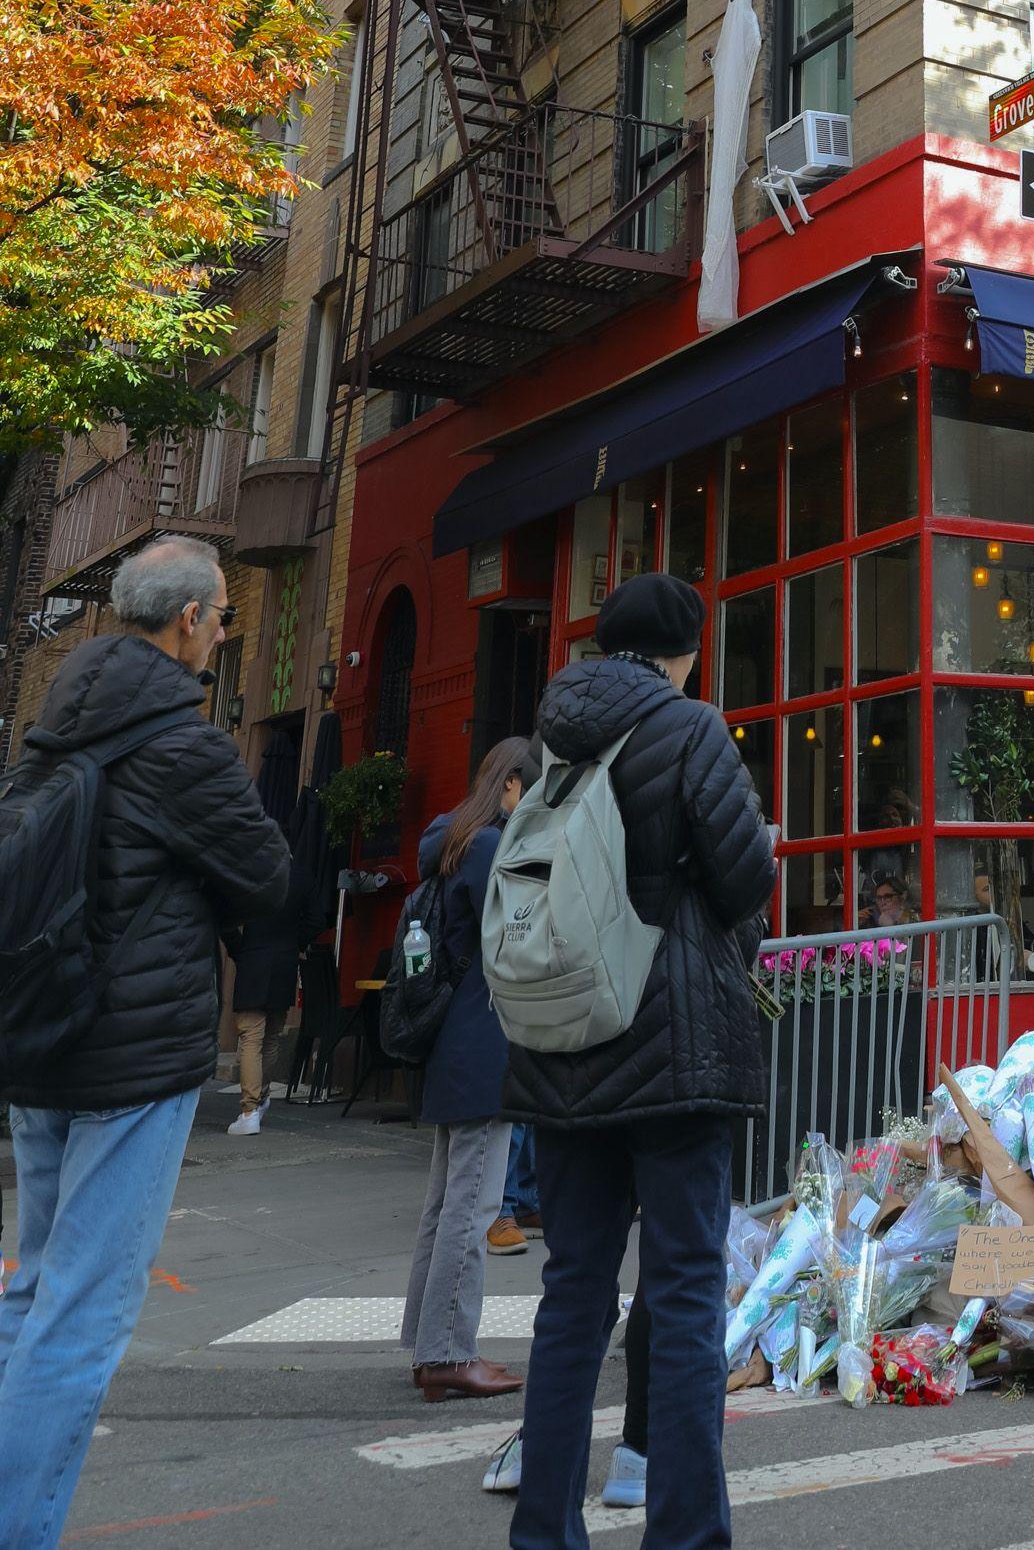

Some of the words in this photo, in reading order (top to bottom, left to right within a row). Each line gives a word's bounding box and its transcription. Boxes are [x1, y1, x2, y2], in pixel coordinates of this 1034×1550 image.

[993, 94, 1034, 134] Grove
[505, 922, 532, 931] SIERRA
[508, 932, 525, 941] CLUB
[960, 1249, 1002, 1258] where
[962, 1262, 986, 1272] say
